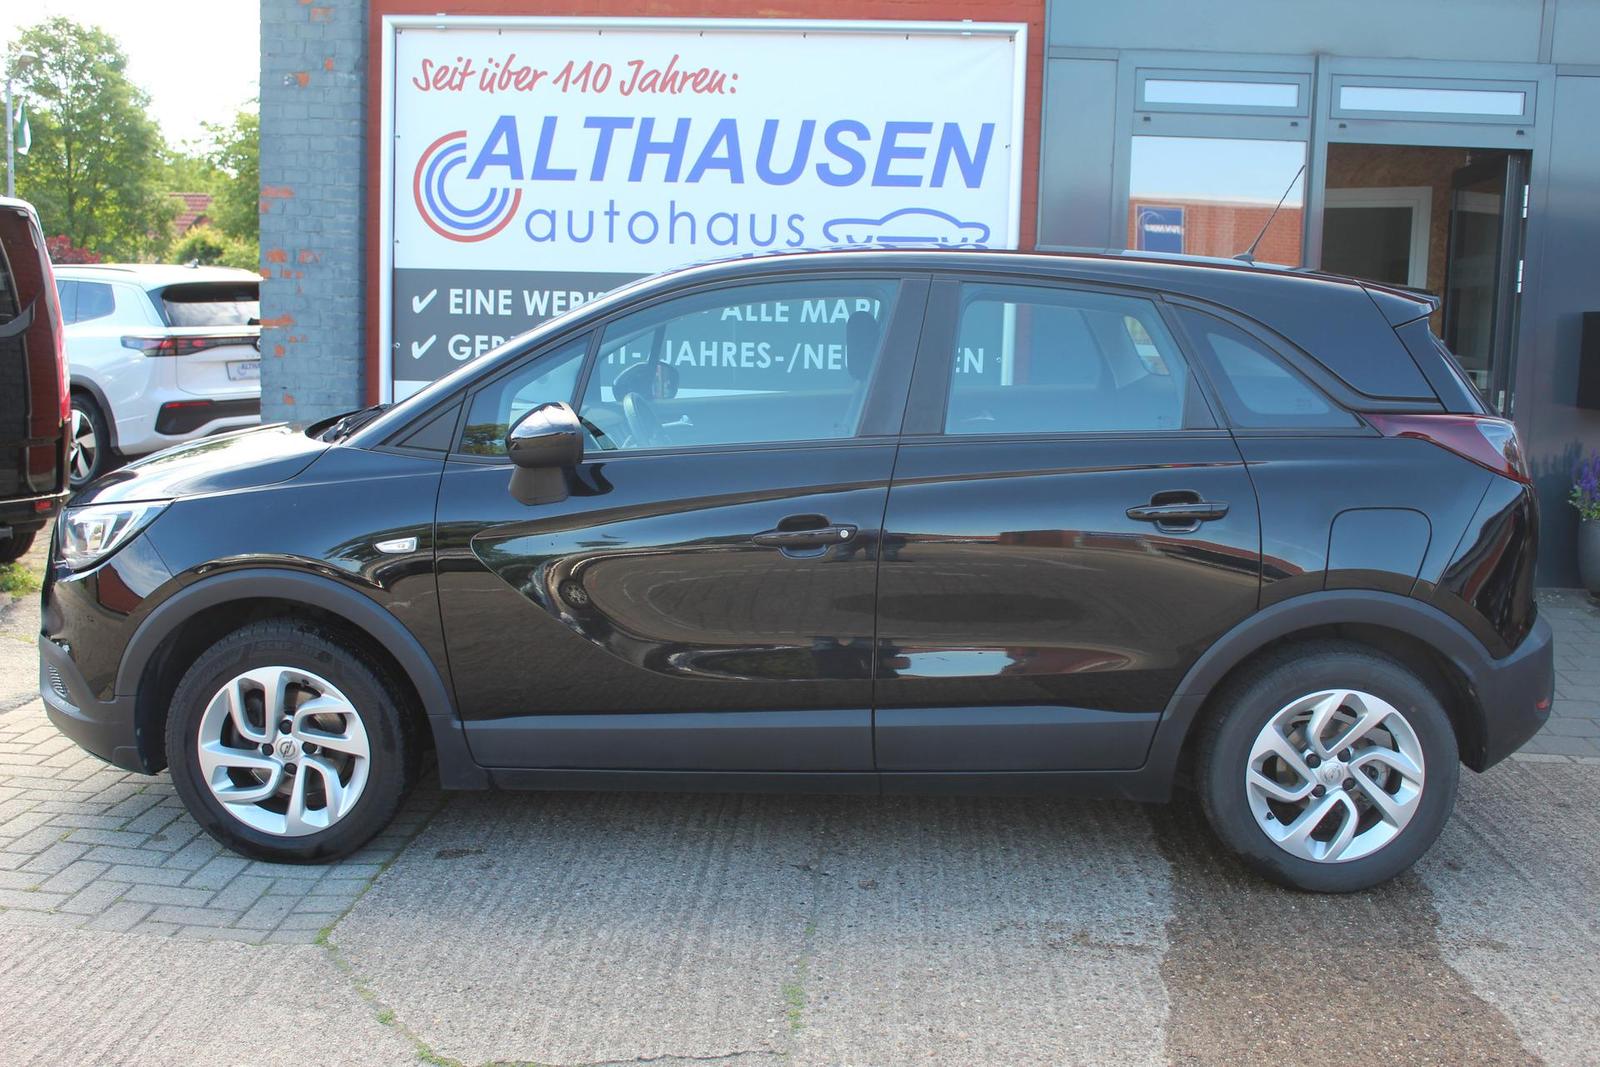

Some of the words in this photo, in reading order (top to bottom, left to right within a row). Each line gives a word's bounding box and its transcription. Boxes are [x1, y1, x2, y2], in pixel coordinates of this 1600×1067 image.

[412, 56, 476, 92] Seit
[479, 53, 549, 94] über
[552, 60, 613, 93] 110
[619, 54, 739, 97] Jahren:
[466, 114, 996, 189] ALTHAUSEN
[524, 199, 806, 247] autohaus
[449, 288, 513, 317] EINE
[720, 302, 790, 323] ALLE
